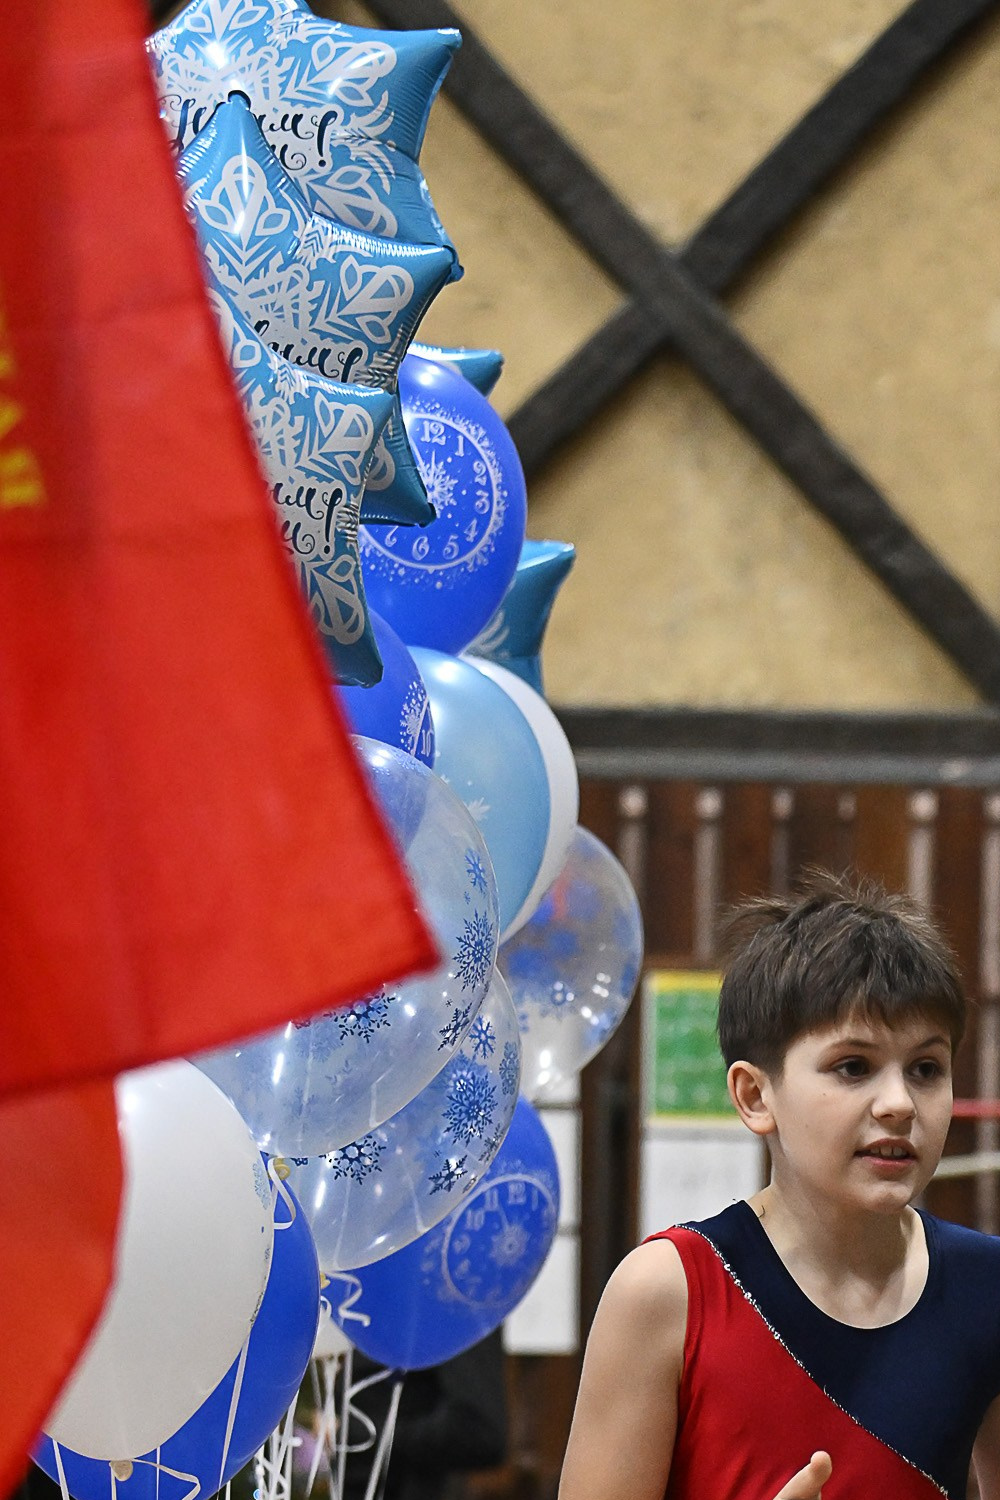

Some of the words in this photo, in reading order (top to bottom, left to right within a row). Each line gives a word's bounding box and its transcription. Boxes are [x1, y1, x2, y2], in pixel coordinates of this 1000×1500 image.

[420, 420, 446, 446] 12
[454, 435, 465, 457] 1
[473, 461, 487, 486] 2
[475, 489, 490, 515] 3
[463, 518, 479, 543] 4
[412, 536, 430, 561] 6
[442, 534, 459, 560] 5
